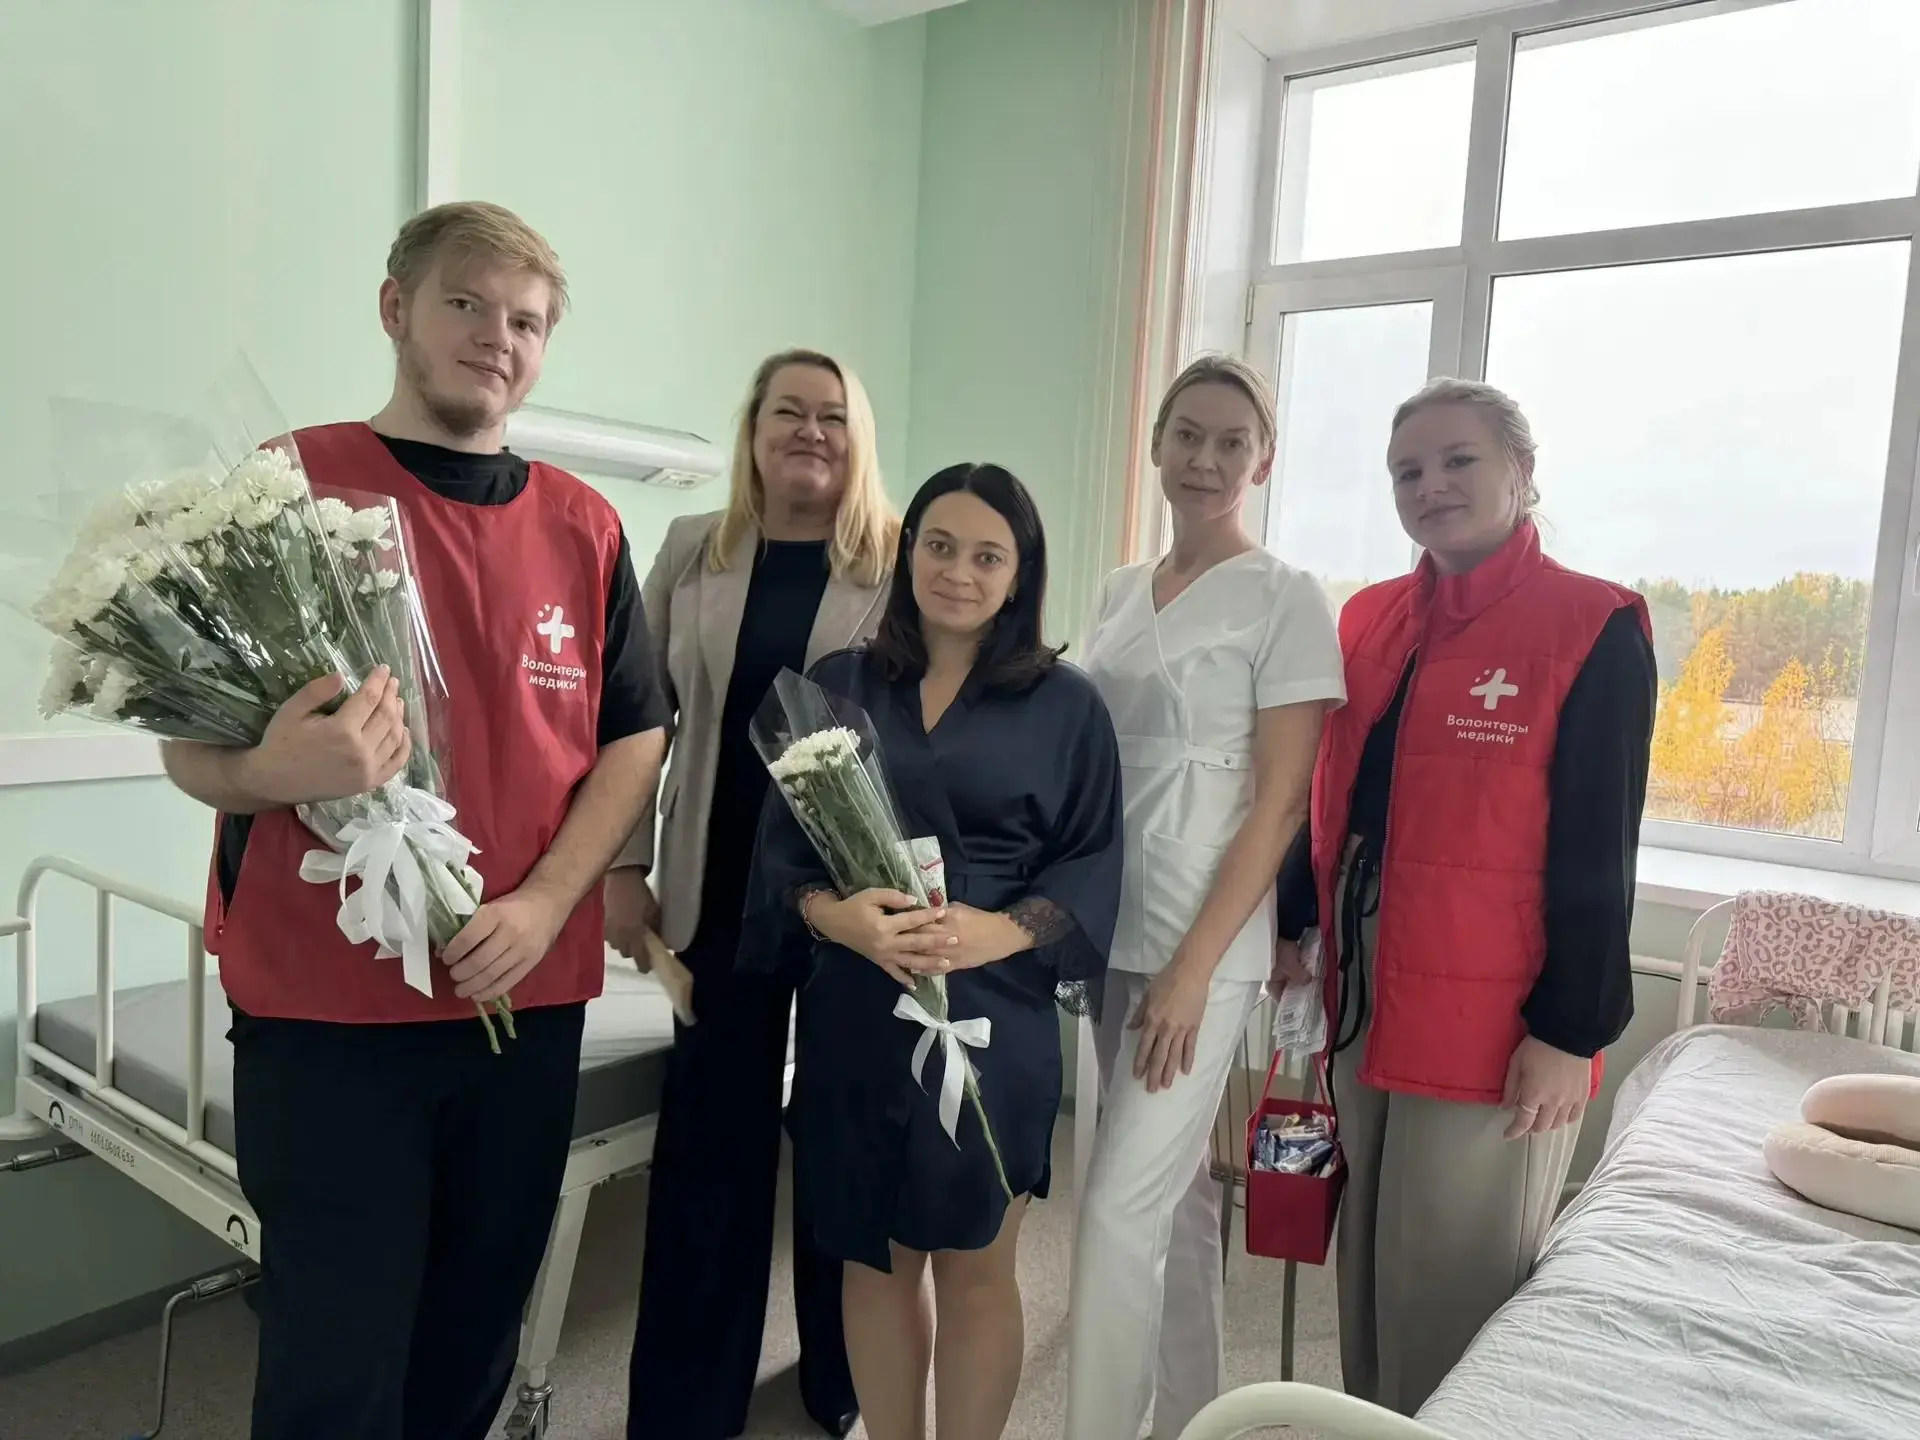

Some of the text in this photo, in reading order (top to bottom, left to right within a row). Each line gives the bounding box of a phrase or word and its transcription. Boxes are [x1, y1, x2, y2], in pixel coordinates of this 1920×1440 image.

[521, 653, 588, 680] Волонтеры
[529, 675, 577, 690] медики
[1447, 714, 1529, 735] Волонтеры
[1456, 730, 1515, 744] медики
